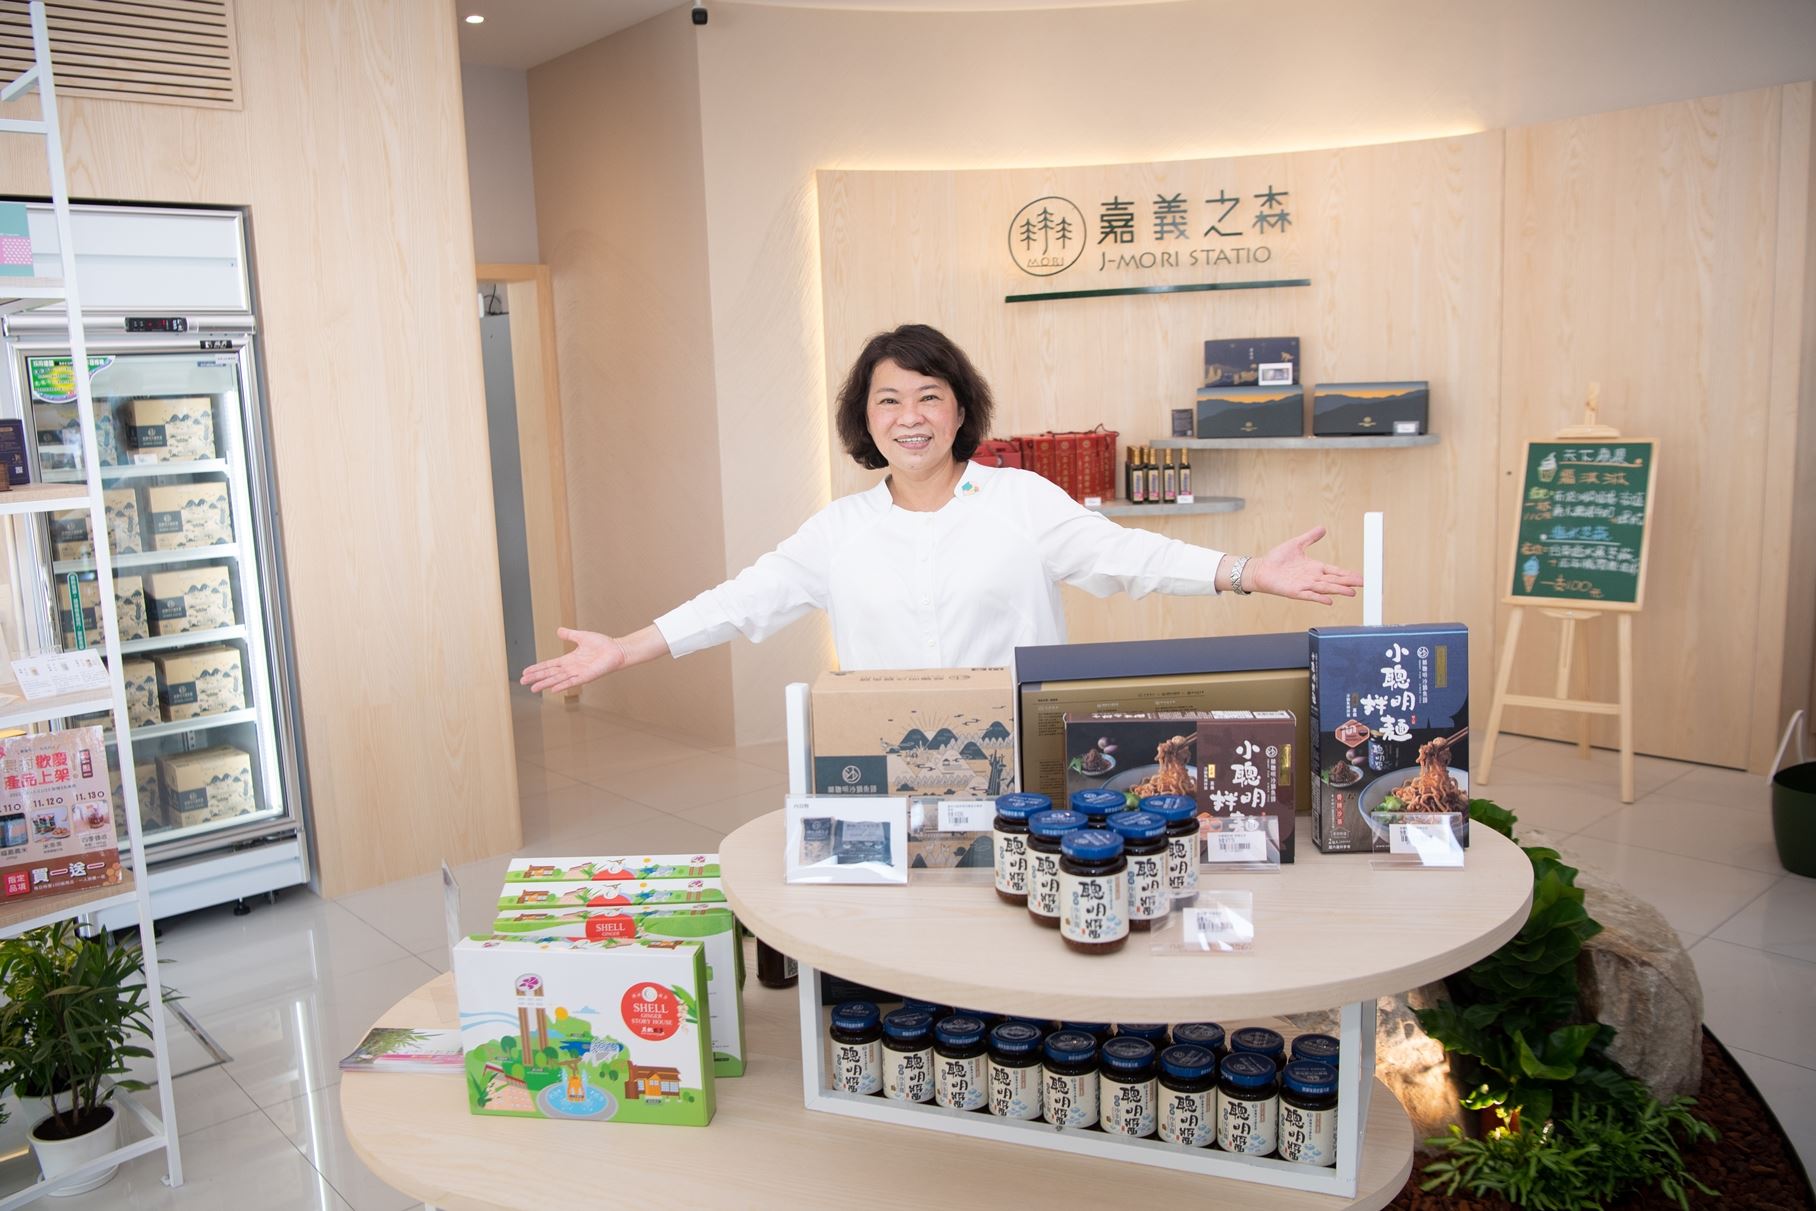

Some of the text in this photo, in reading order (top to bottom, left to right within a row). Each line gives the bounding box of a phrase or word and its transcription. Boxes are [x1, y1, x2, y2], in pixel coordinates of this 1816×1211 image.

[1098, 185, 1292, 245] 嘉義之森
[1027, 257, 1064, 268] MORI
[1099, 246, 1272, 271] J-MORI STATIO
[32, 861, 105, 884] 買一送一
[596, 923, 625, 932] SHELL
[633, 1003, 669, 1013] SHELL
